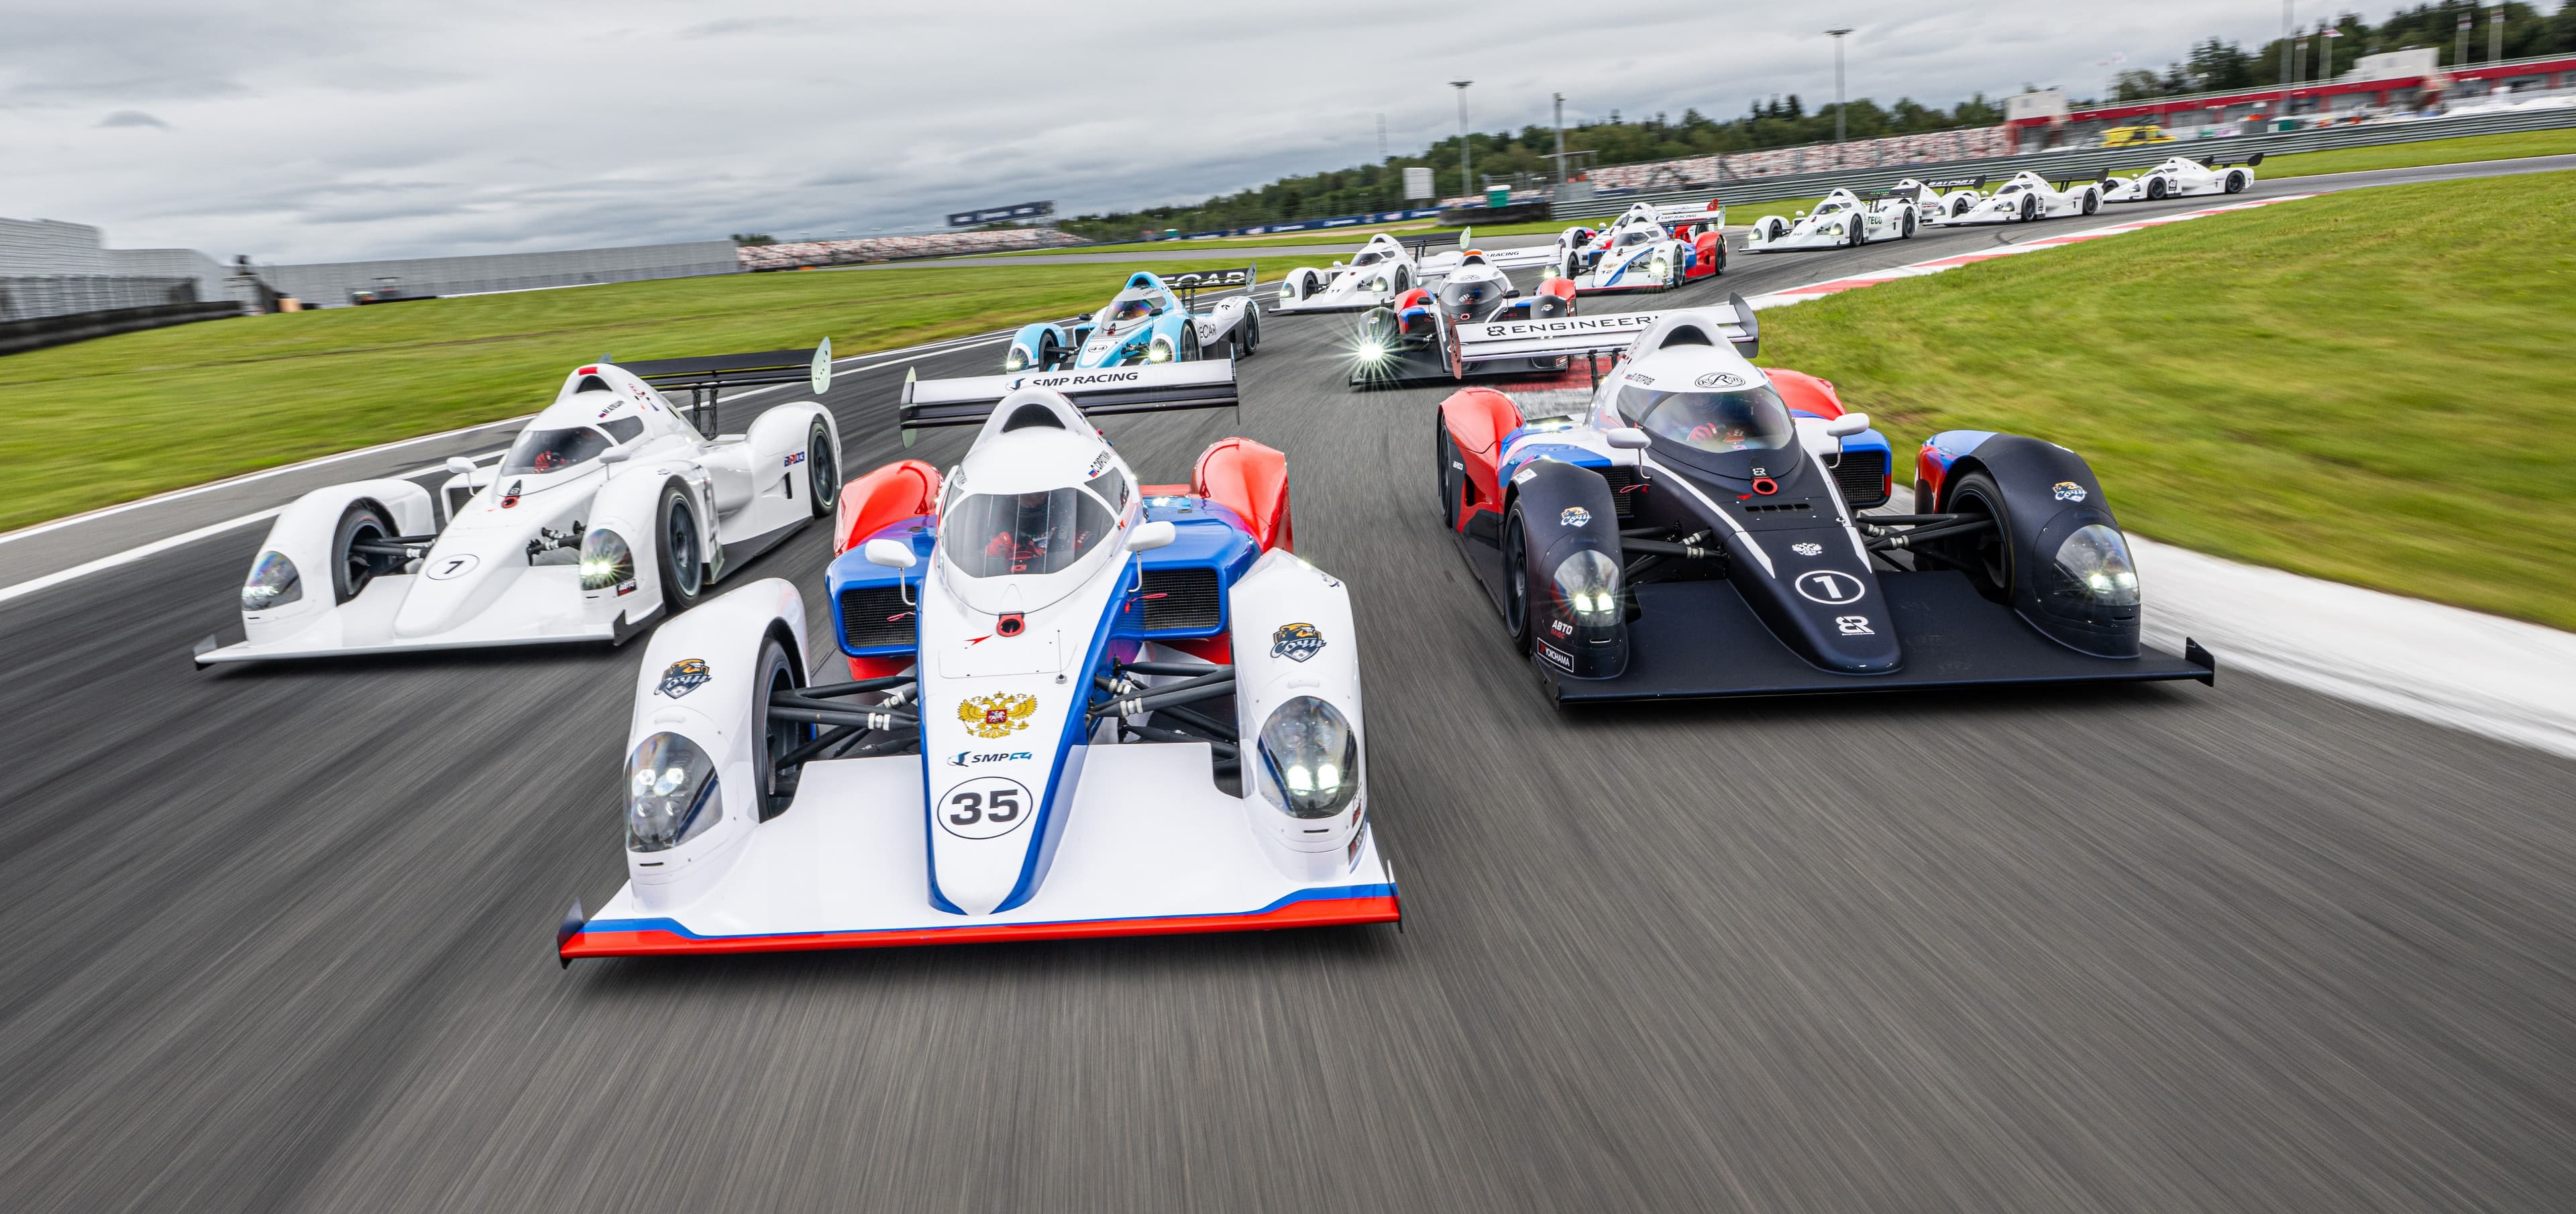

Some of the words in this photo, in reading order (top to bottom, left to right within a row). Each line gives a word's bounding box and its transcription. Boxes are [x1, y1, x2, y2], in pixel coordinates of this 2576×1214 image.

[1511, 315, 1658, 334] ENGINEER
[1032, 377, 1069, 387] SMP
[1073, 372, 1138, 384] RACING
[443, 560, 464, 574] 7
[1813, 575, 1842, 598] 1
[1552, 619, 1573, 635] АВТО
[1271, 638, 1327, 659] Сочи
[1545, 647, 1570, 667] YOKOHAMA
[950, 789, 1019, 826] 35
